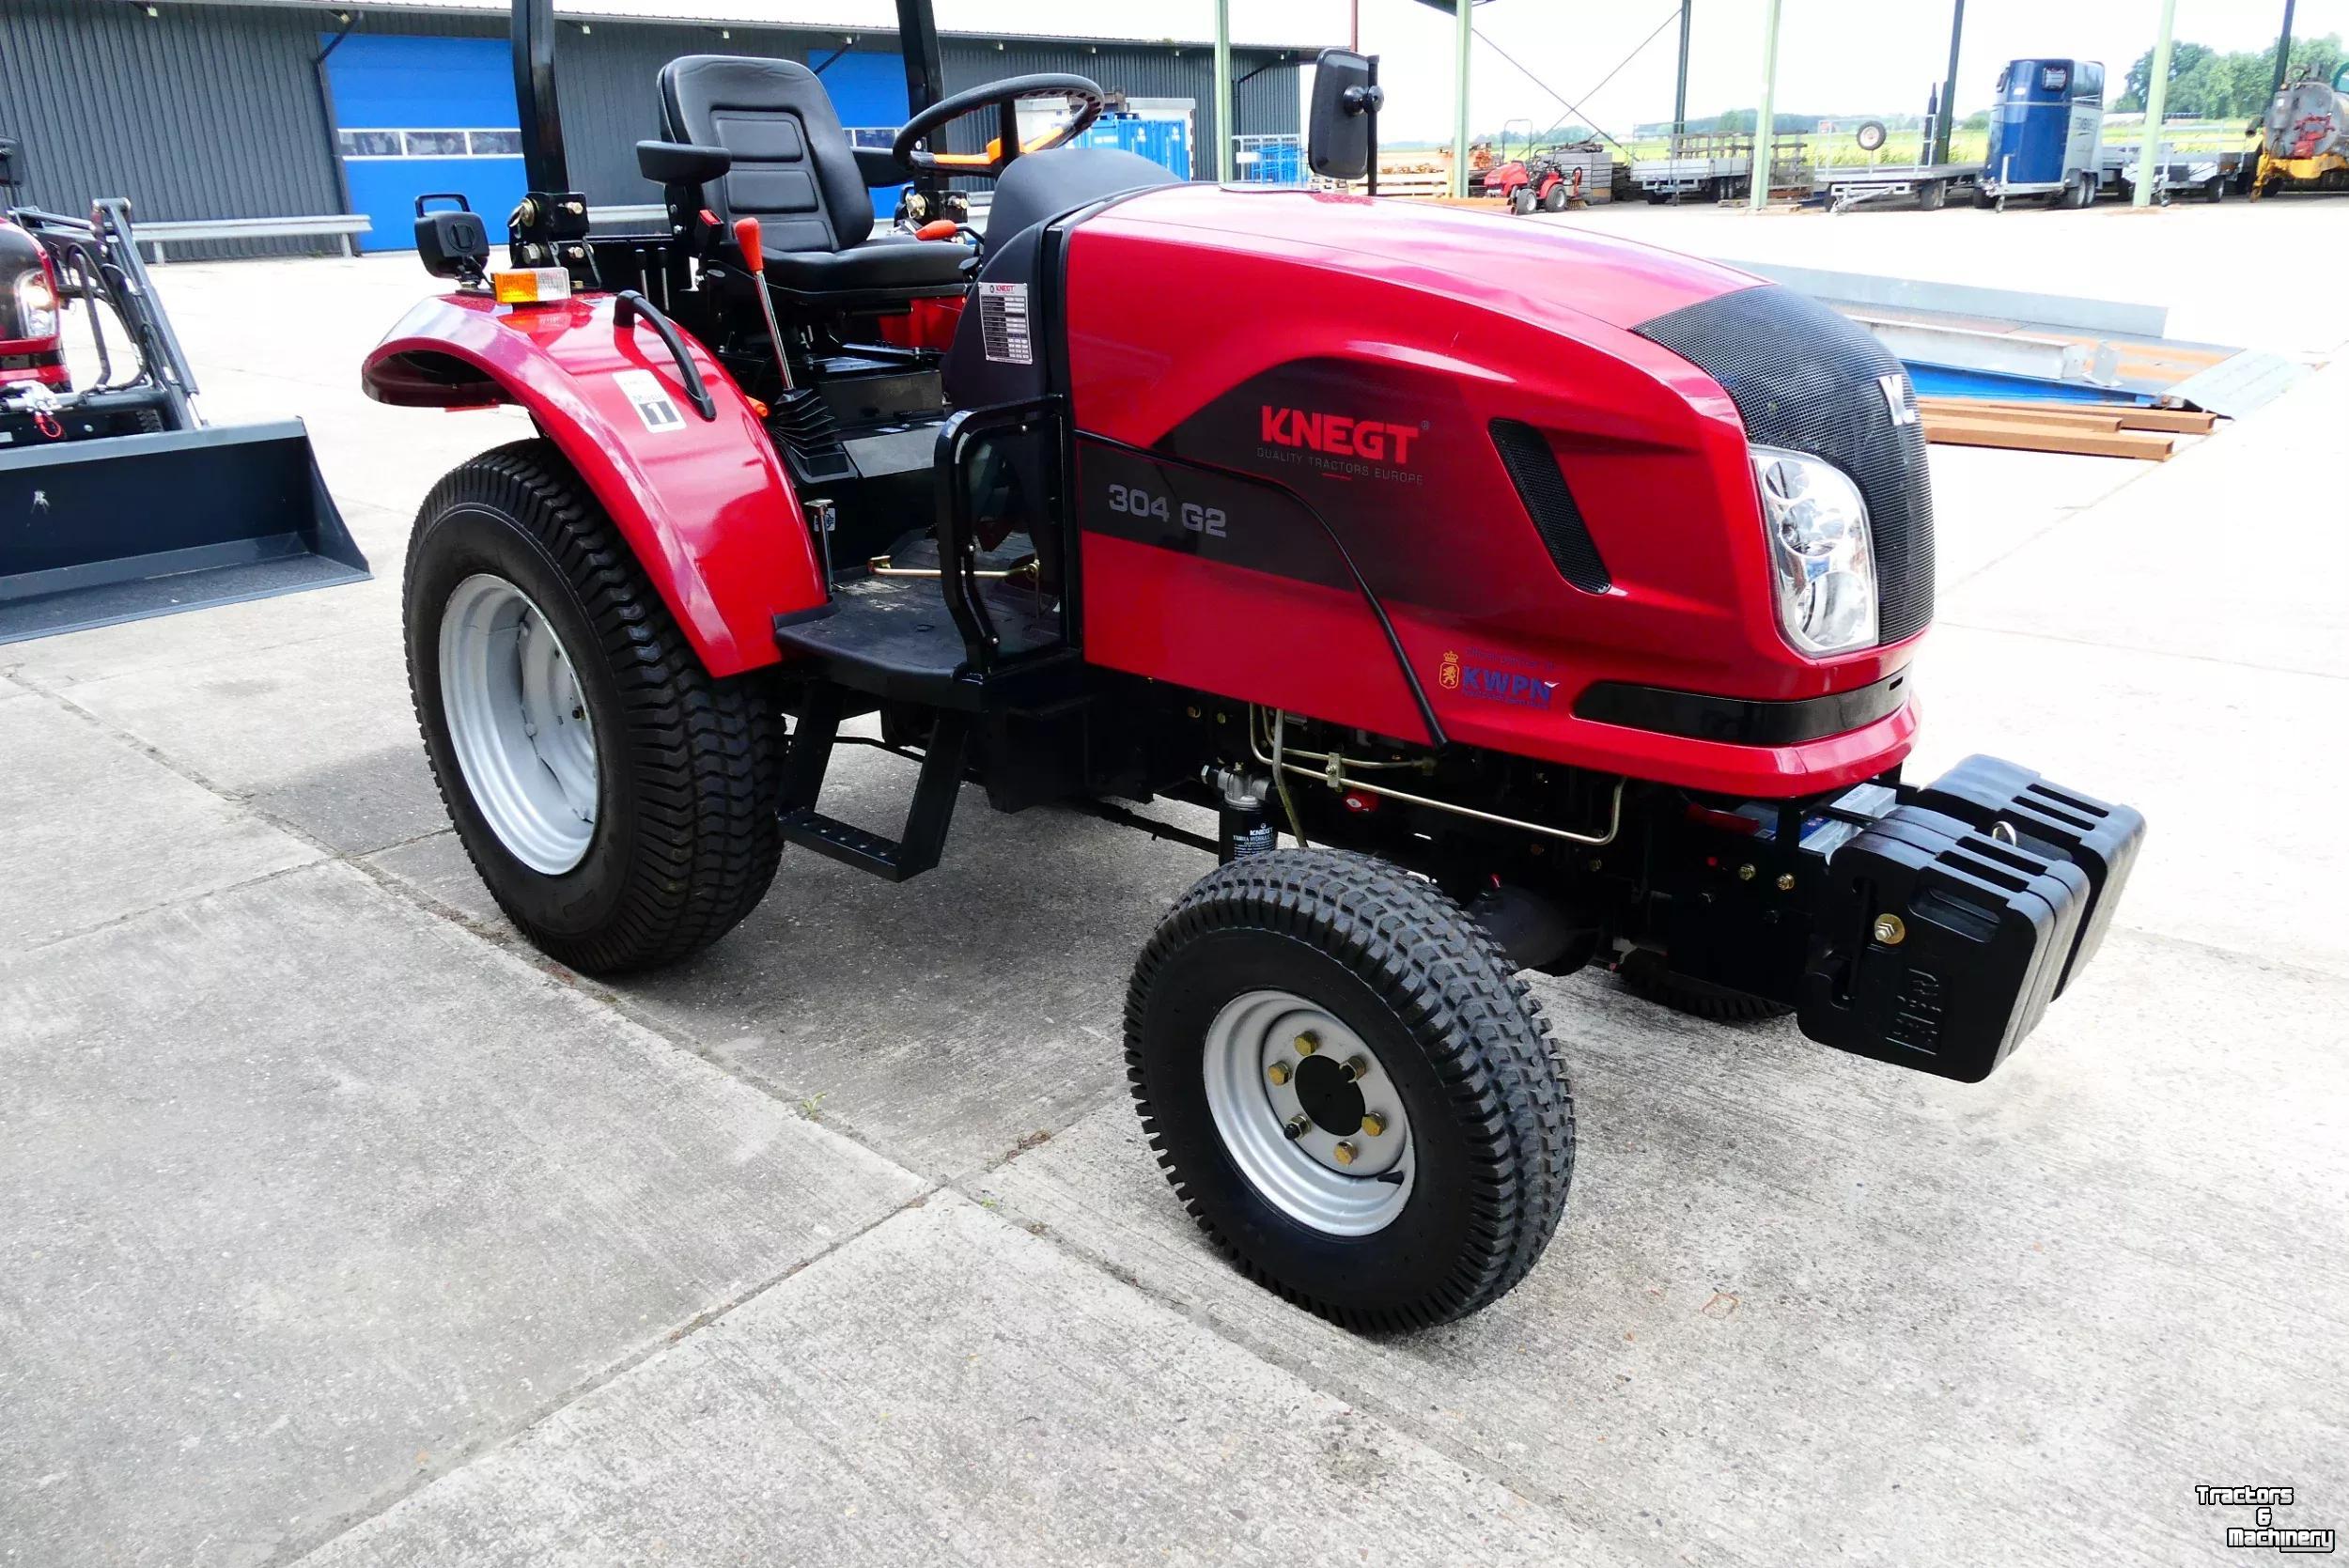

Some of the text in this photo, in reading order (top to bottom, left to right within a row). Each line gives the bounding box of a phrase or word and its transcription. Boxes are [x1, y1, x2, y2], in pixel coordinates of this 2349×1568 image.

[1261, 405, 1419, 465] KNEGT
[1257, 446, 1423, 486] QUALITY TRACTORS EUROPE
[1108, 483, 1227, 537] 304 G2
[1463, 666, 1552, 701] KWPN
